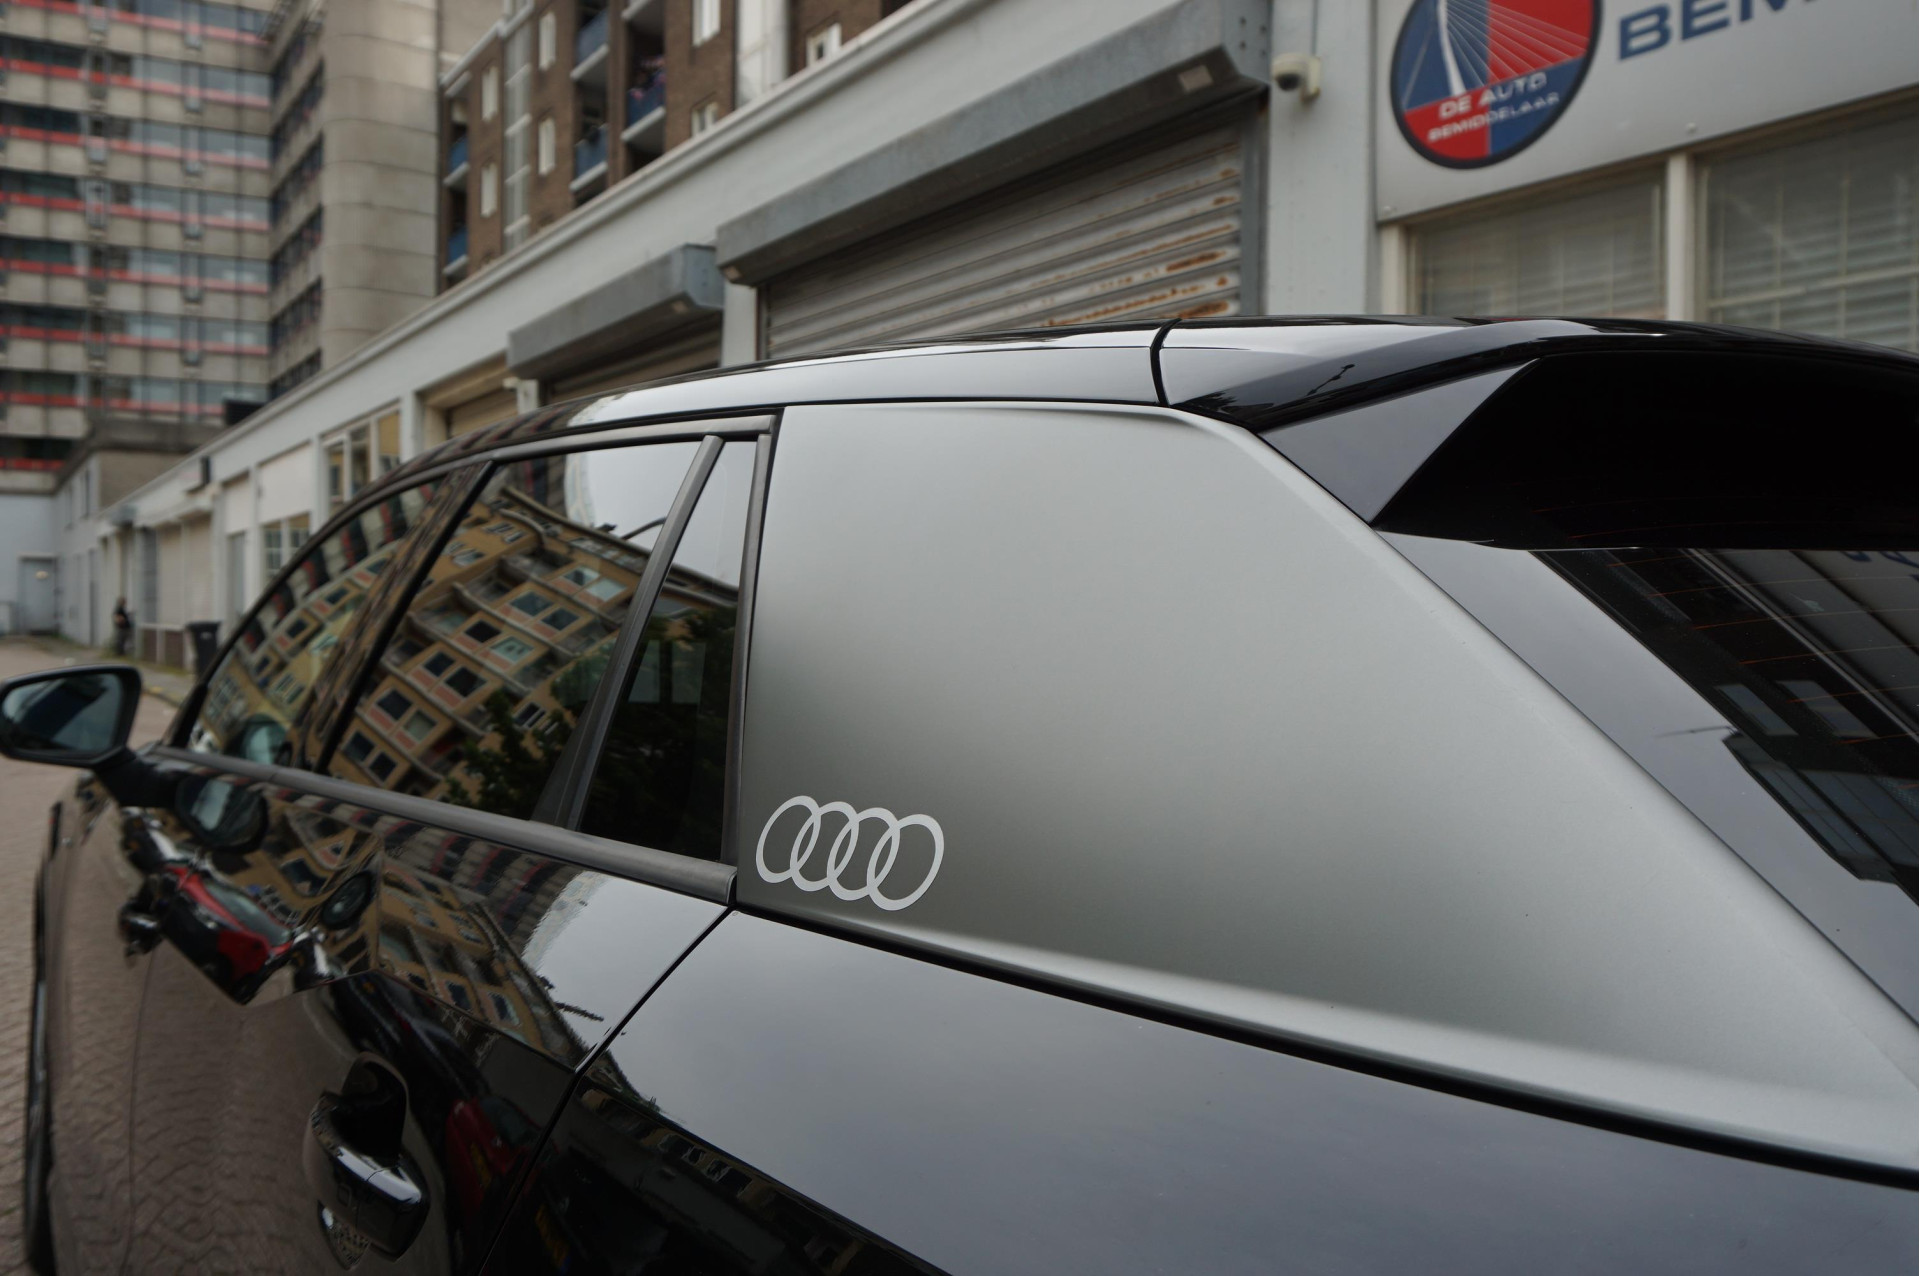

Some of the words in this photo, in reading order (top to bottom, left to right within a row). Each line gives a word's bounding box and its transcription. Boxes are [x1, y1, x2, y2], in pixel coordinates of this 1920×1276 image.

[1428, 92, 1559, 141] BEMIDDELAAR
[1439, 95, 1472, 119] DE
[1478, 72, 1547, 107] AUTO
